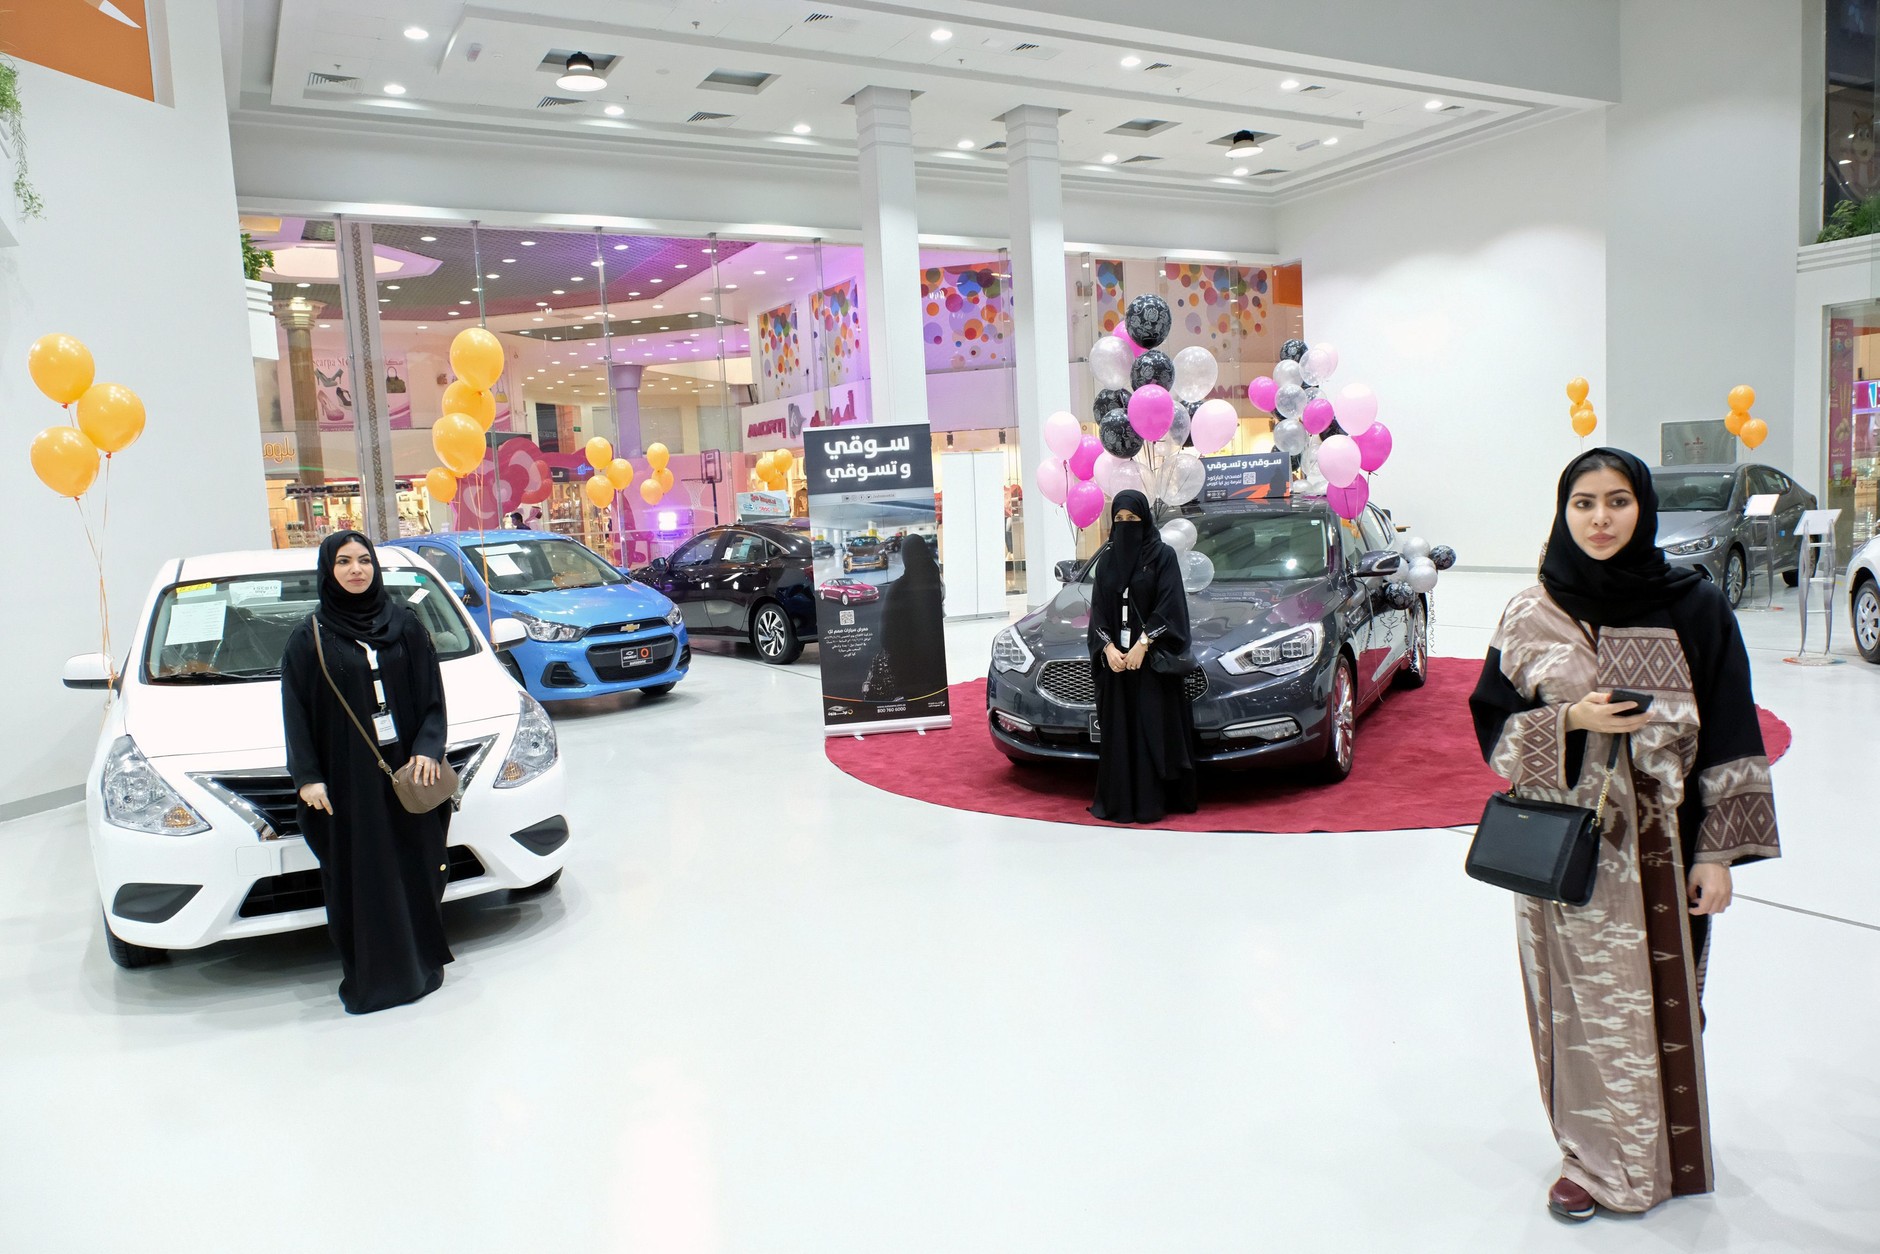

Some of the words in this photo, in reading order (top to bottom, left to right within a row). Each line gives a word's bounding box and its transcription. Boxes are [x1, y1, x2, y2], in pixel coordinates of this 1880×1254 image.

[314, 359, 335, 369] carpa
[824, 435, 910, 460] سوقي
[1248, 458, 1282, 469] سوقي
